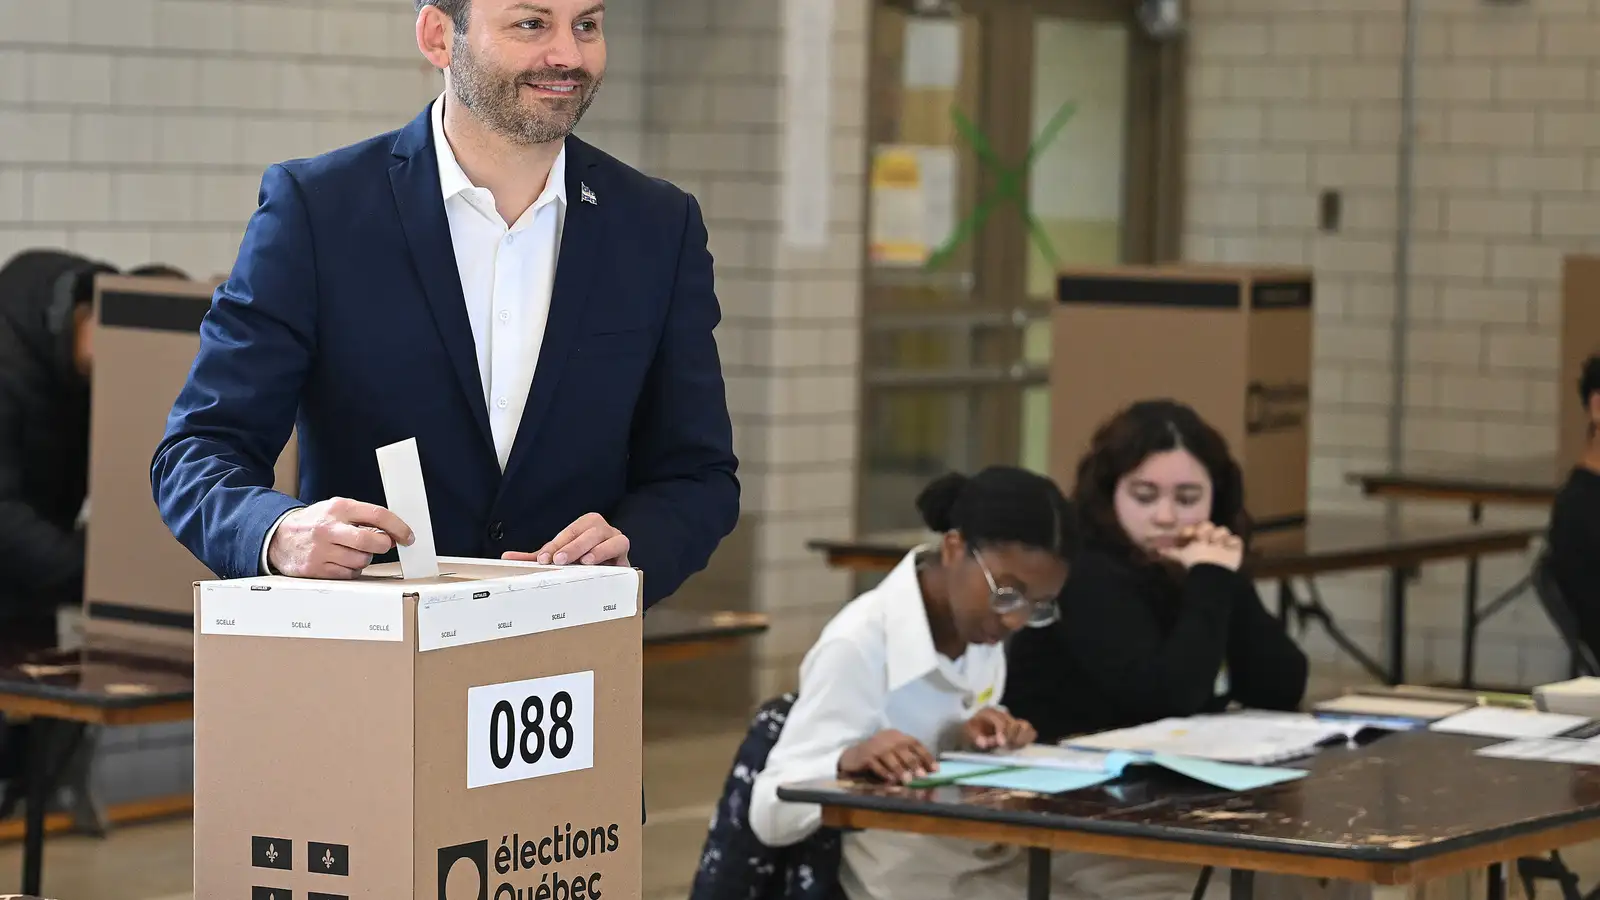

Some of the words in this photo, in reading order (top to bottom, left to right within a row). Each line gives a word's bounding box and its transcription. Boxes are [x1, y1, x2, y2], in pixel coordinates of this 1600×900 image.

[216, 618, 236, 626] SCELLÉ
[291, 621, 311, 629] SCELLÉ
[369, 624, 389, 632] SCELLÉ
[441, 629, 457, 638] SCELLÉ
[497, 621, 512, 629] SCELLÉ
[551, 612, 566, 620] SCELLÉ
[603, 603, 617, 612] SCELLÉ
[490, 690, 574, 769] 088
[494, 823, 619, 874] élections
